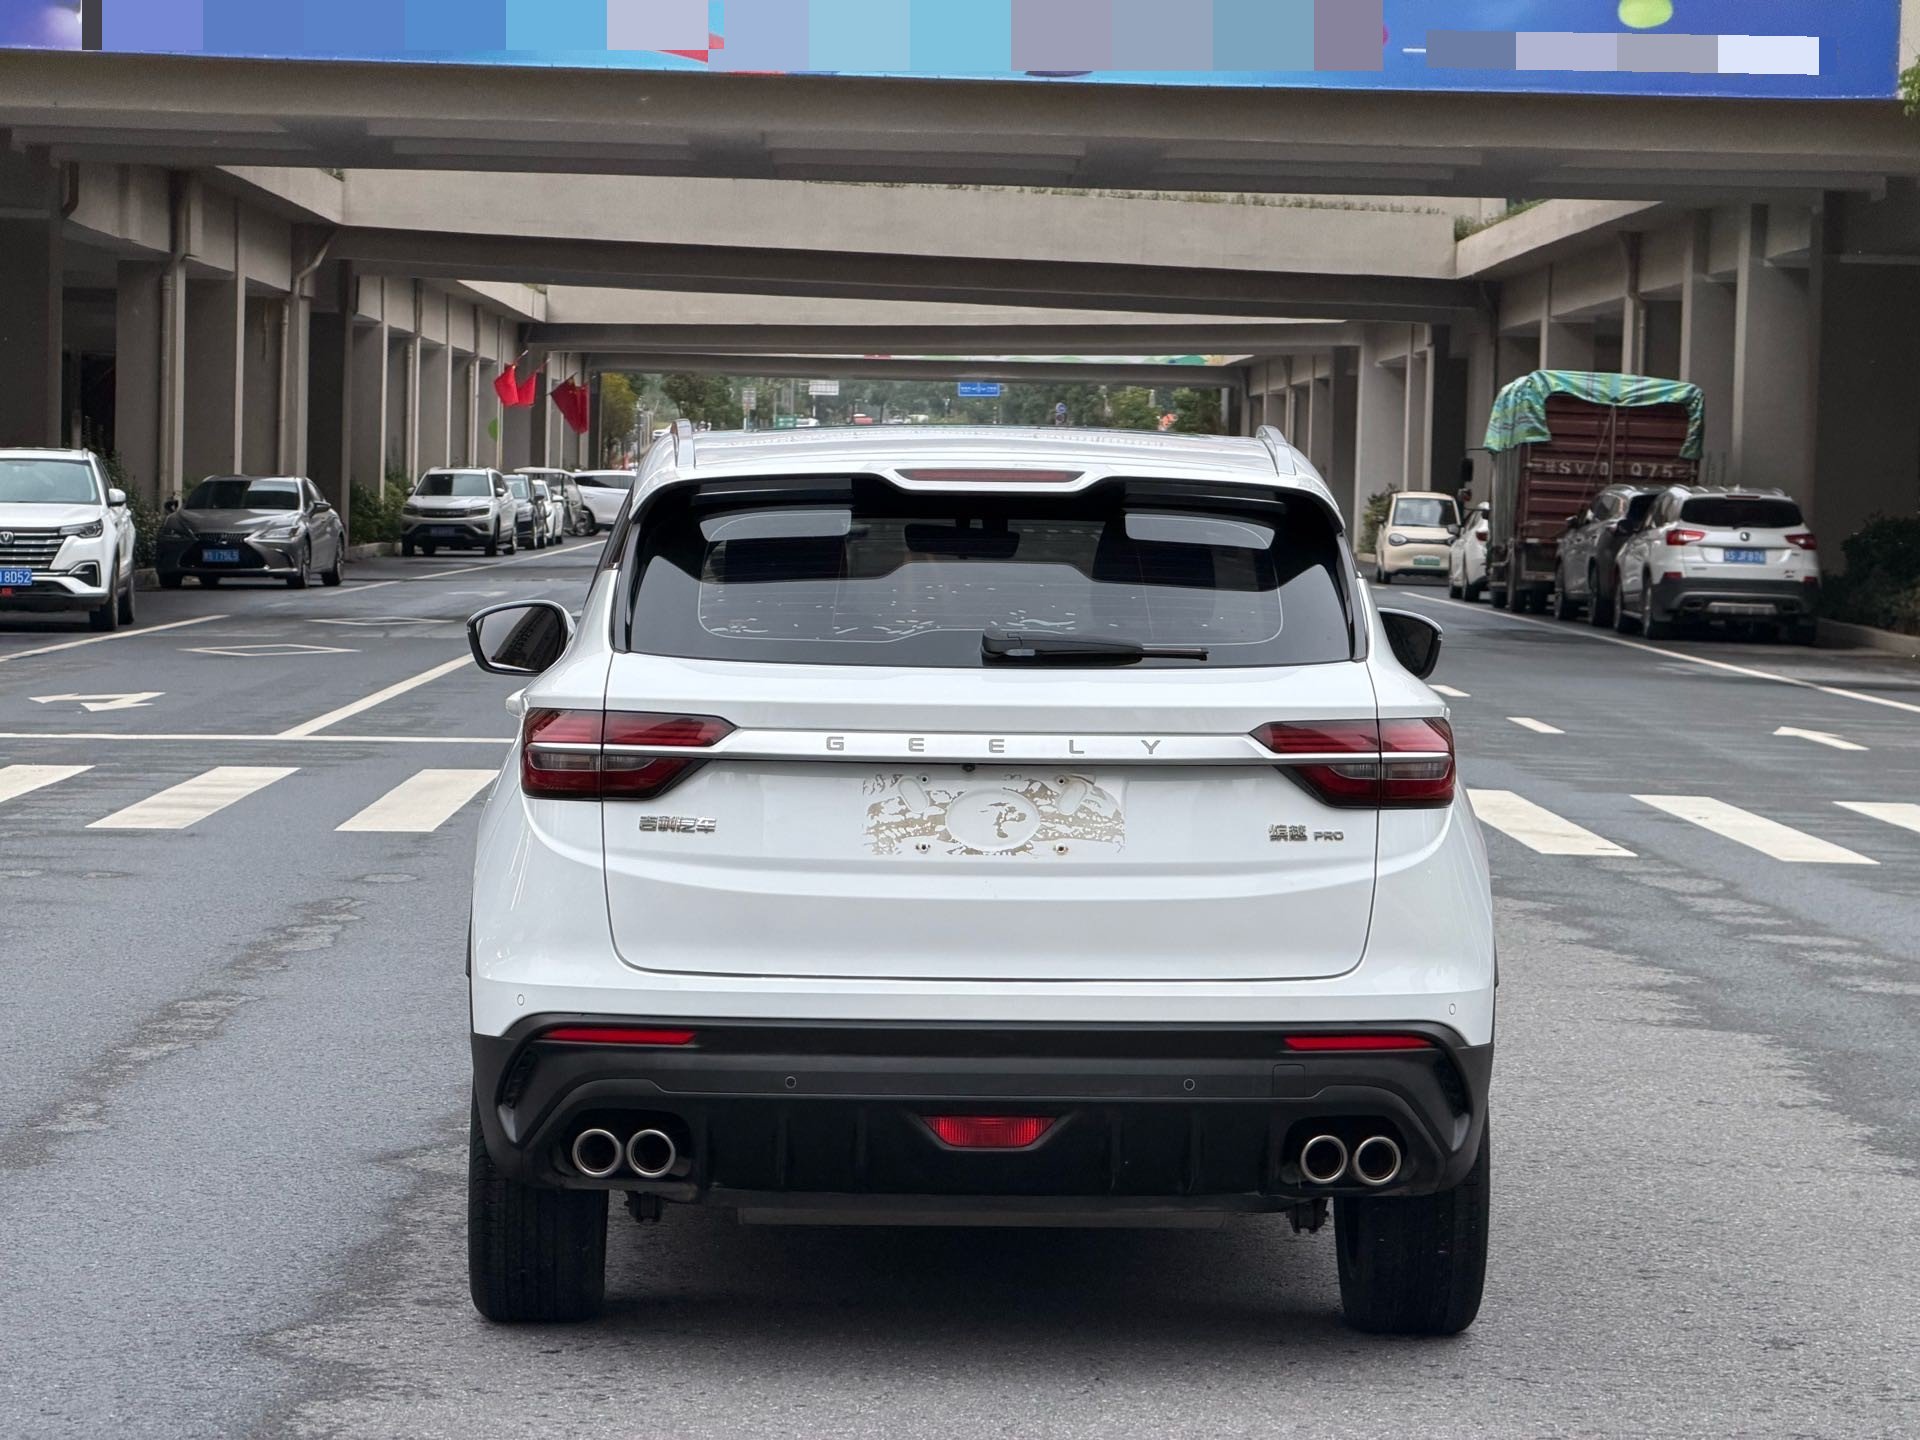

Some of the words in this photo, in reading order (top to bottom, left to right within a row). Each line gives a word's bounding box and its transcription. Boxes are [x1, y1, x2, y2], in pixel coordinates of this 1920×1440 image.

[0, 571, 31, 583] 8D52
[826, 736, 1161, 755] GEELY
[1313, 831, 1344, 841] PRO
